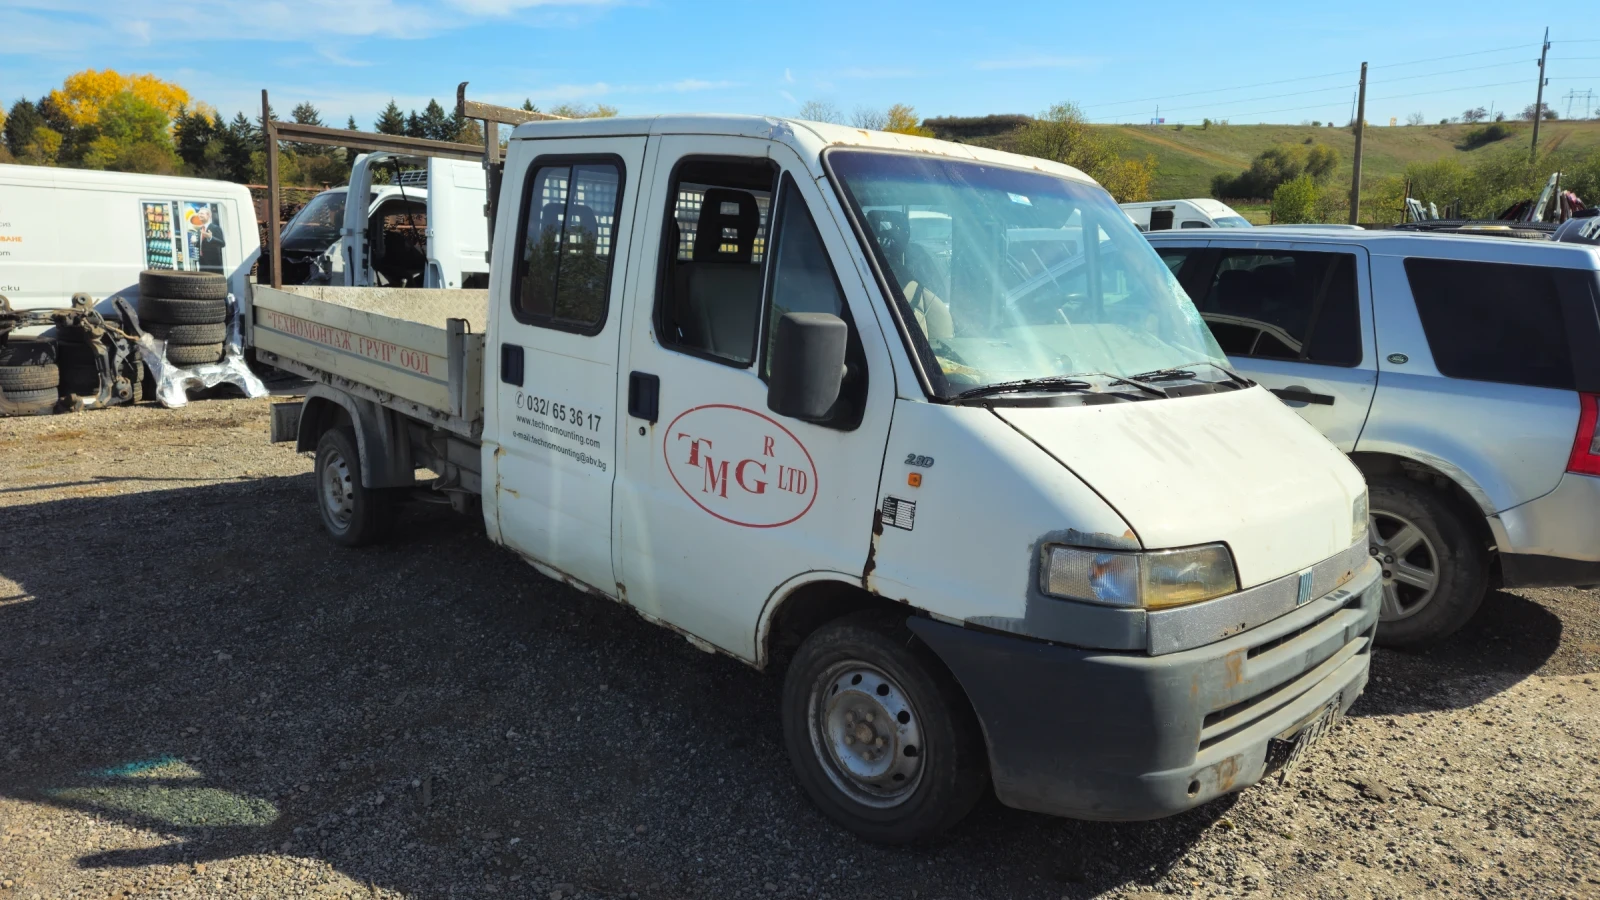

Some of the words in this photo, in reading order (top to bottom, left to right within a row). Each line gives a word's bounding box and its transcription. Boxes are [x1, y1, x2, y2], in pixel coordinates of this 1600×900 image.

[400, 348, 430, 375] ООД
[527, 395, 550, 416] 032/
[552, 402, 566, 421] 65
[569, 407, 583, 427] 36
[587, 413, 602, 432] 17
[516, 414, 601, 449] www.technomounting.com
[777, 464, 807, 495] LTD
